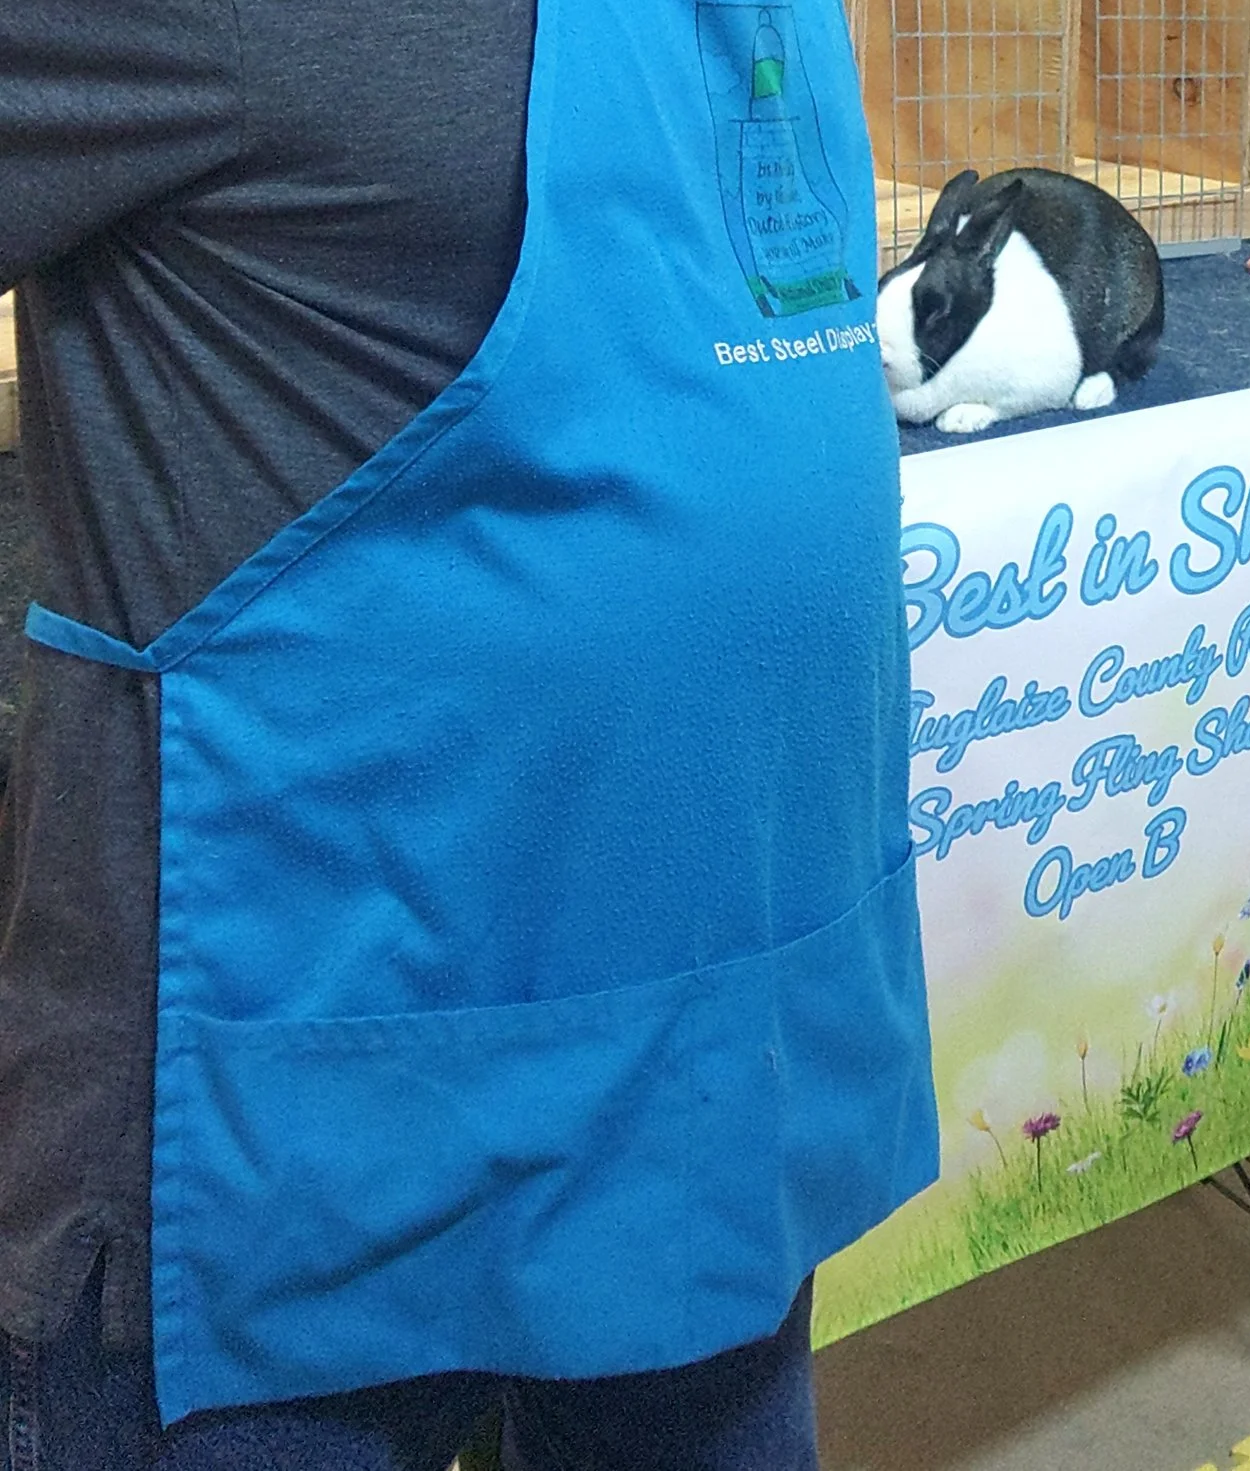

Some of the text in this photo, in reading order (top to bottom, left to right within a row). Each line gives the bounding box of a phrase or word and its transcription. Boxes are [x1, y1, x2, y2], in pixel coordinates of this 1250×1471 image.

[714, 339, 770, 365] Best
[771, 330, 826, 361] Steel
[900, 502, 1073, 652] Best
[1079, 512, 1159, 606] in
[1077, 624, 1223, 706] County
[908, 786, 1066, 860] Spring
[1067, 734, 1183, 807] Fling
[1023, 806, 1187, 922] Open B
